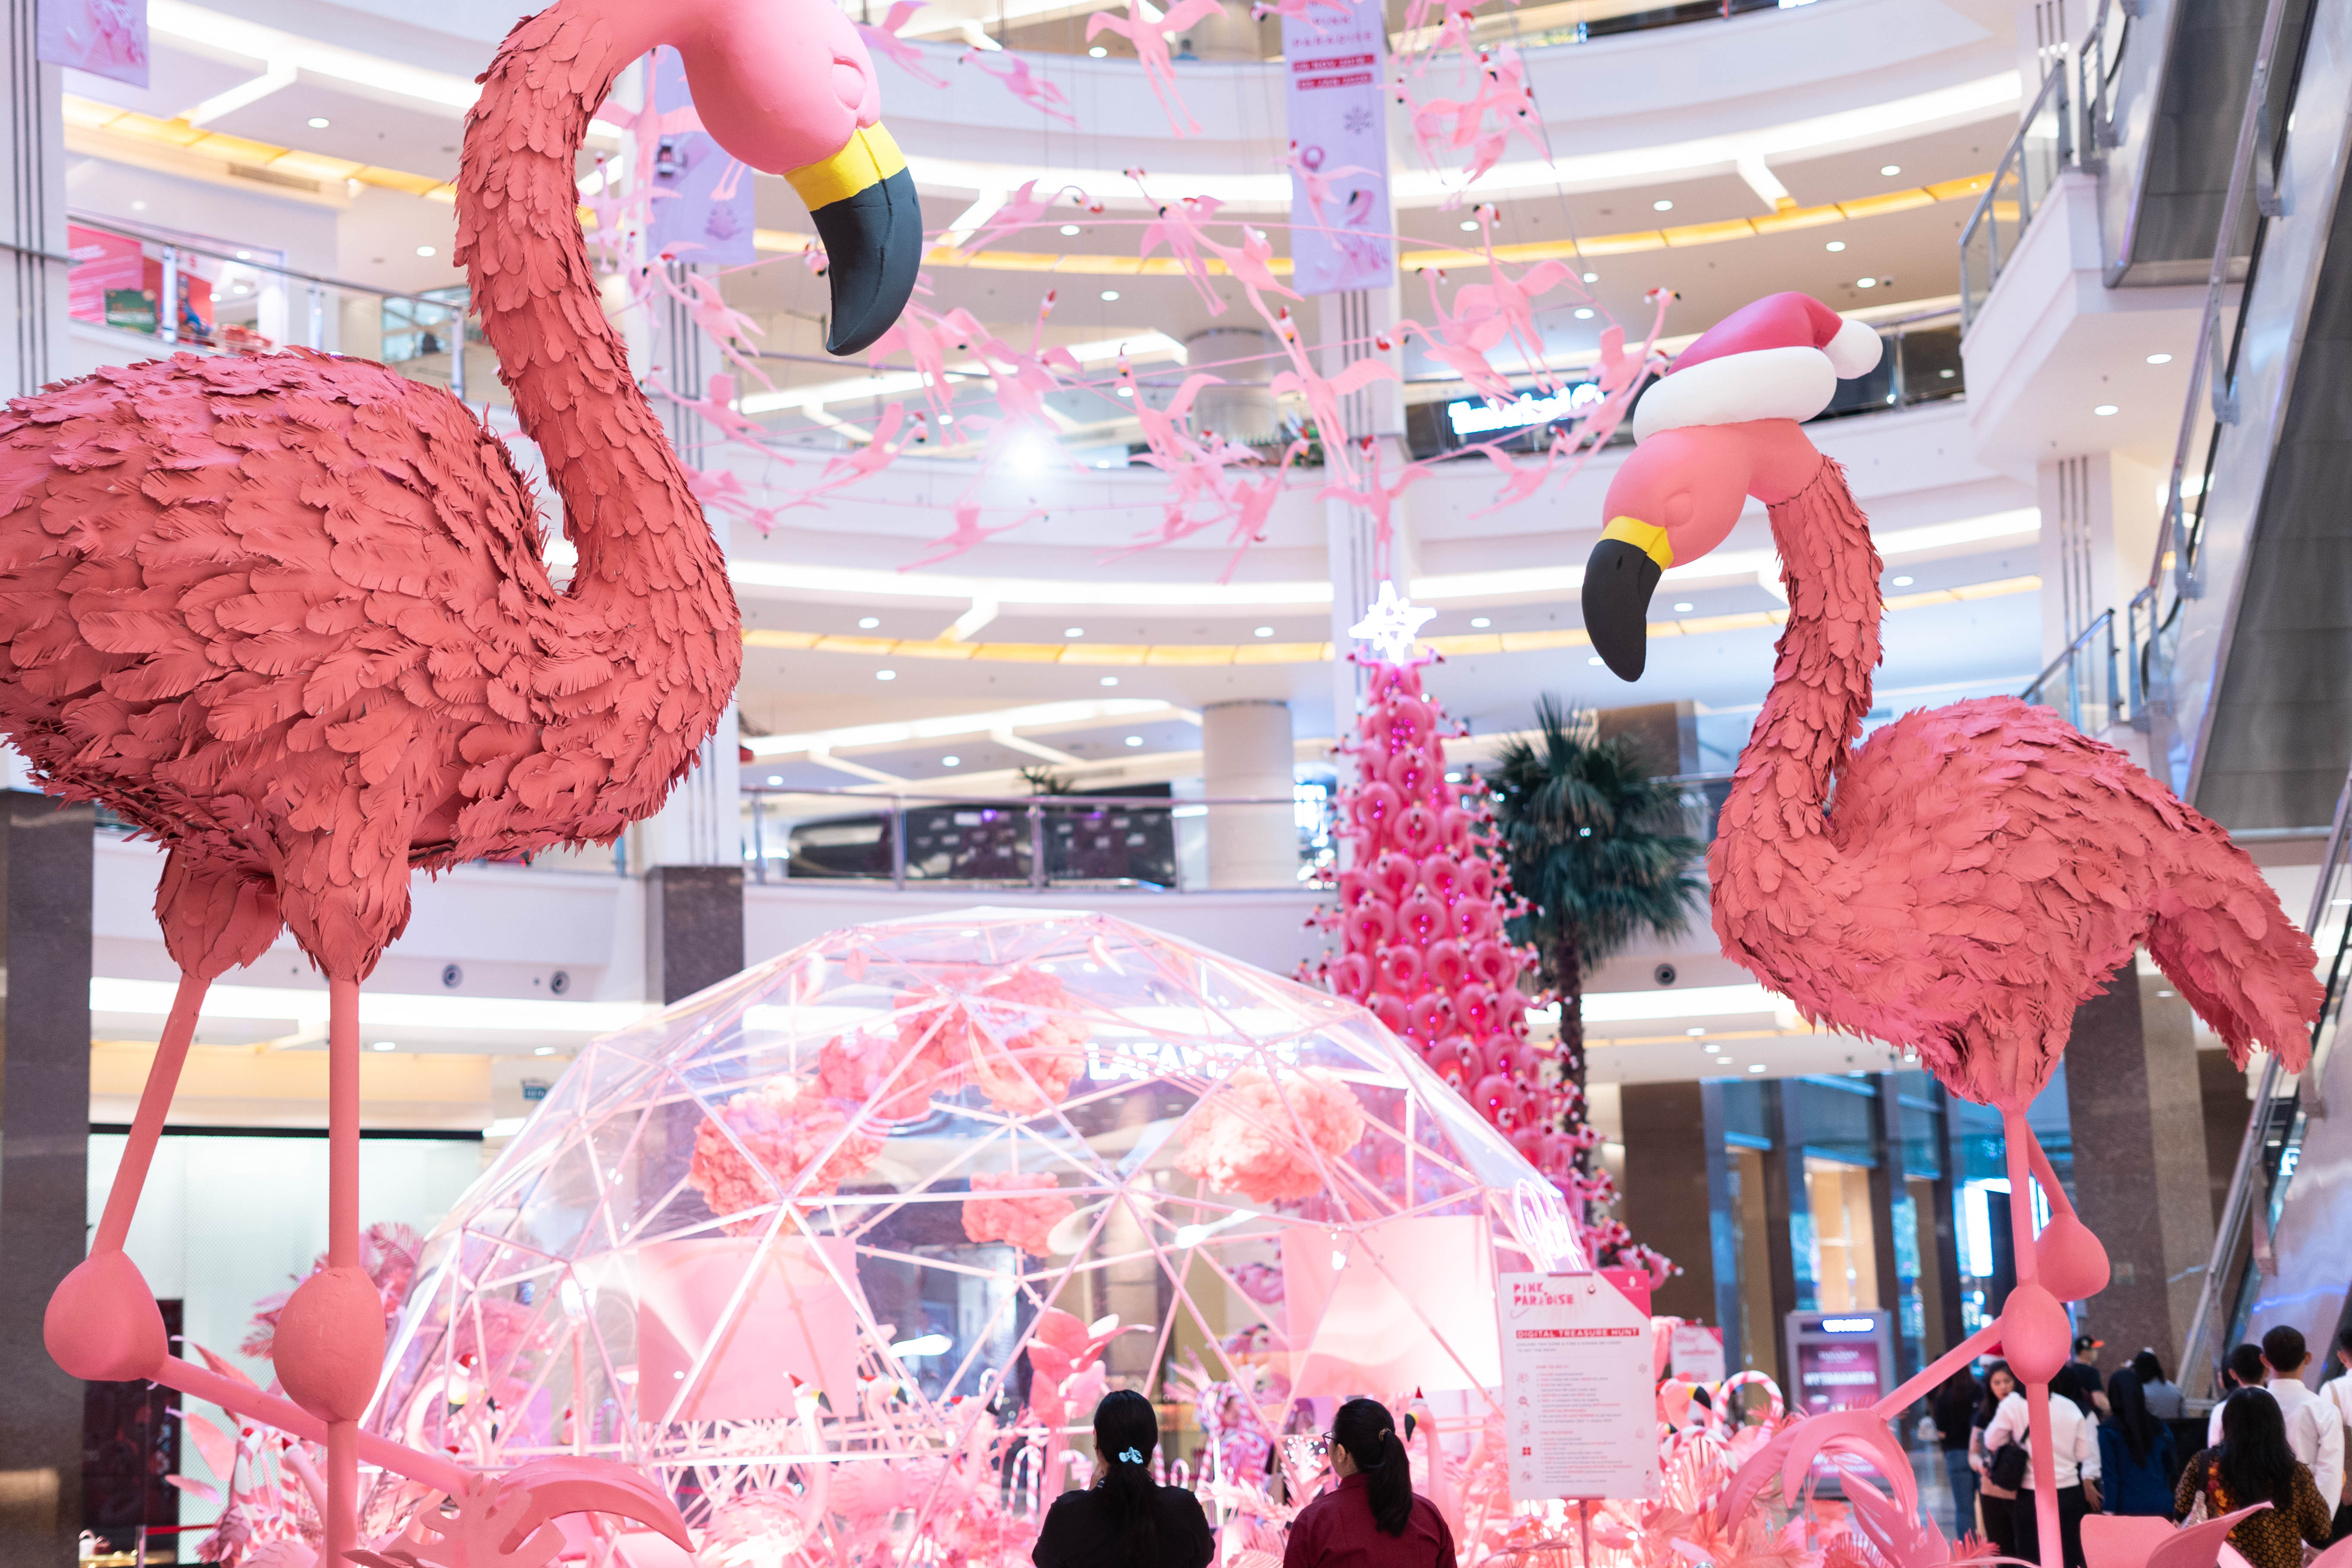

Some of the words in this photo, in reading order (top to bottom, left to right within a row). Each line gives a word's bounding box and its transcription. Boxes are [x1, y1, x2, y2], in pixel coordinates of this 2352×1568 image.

[1514, 1282, 1543, 1293] PINK
[1514, 1294, 1573, 1306] PARADISE
[1517, 1329, 1555, 1338] DIGITAL
[1559, 1328, 1607, 1338] TREASURE
[1611, 1328, 1636, 1336] HUNT
